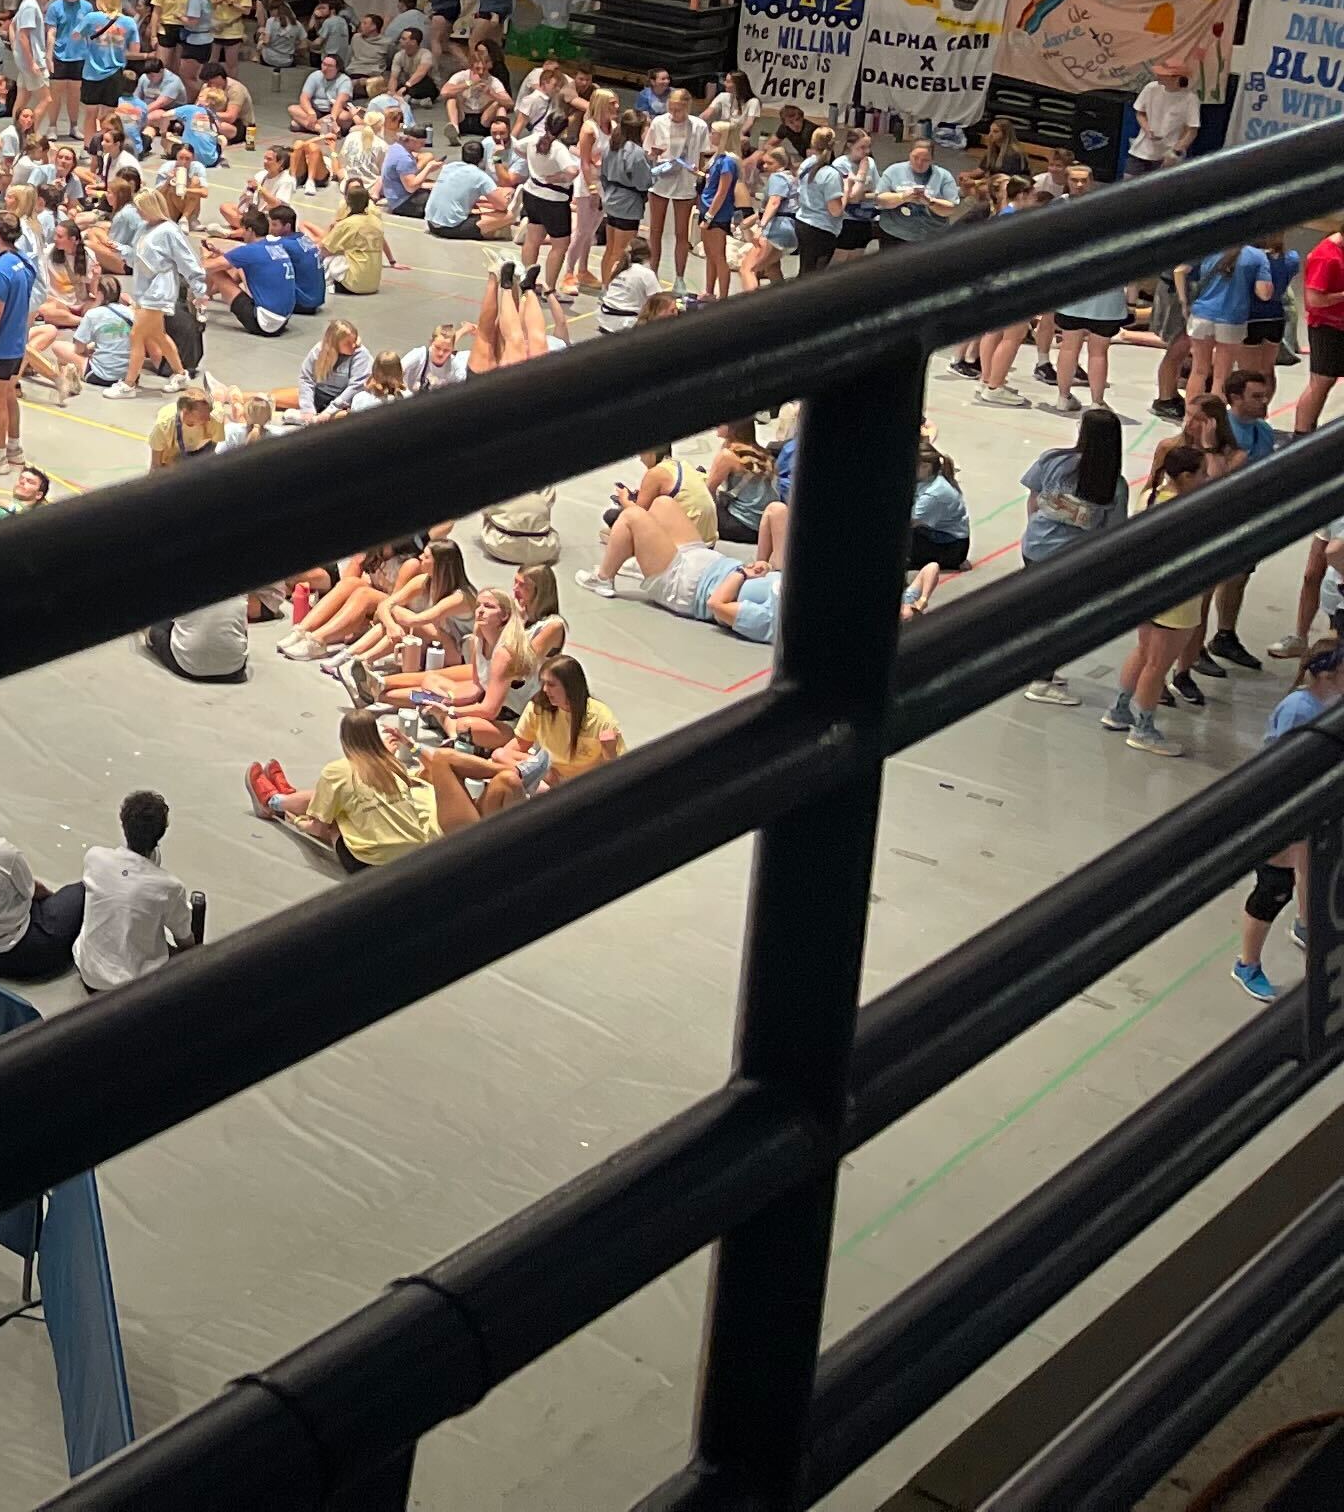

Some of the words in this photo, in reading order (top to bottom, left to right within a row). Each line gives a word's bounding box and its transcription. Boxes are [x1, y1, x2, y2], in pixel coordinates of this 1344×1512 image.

[1067, 4, 1090, 24] We
[744, 23, 769, 39] the
[778, 26, 852, 56] WILLIAM
[868, 29, 938, 51] ALPHA
[947, 33, 990, 51] CAM
[744, 49, 809, 73] express
[816, 53, 831, 73] is
[919, 55, 936, 72] X
[1266, 45, 1344, 93] BLU
[761, 66, 826, 104] here!
[1281, 87, 1343, 118] WITH
